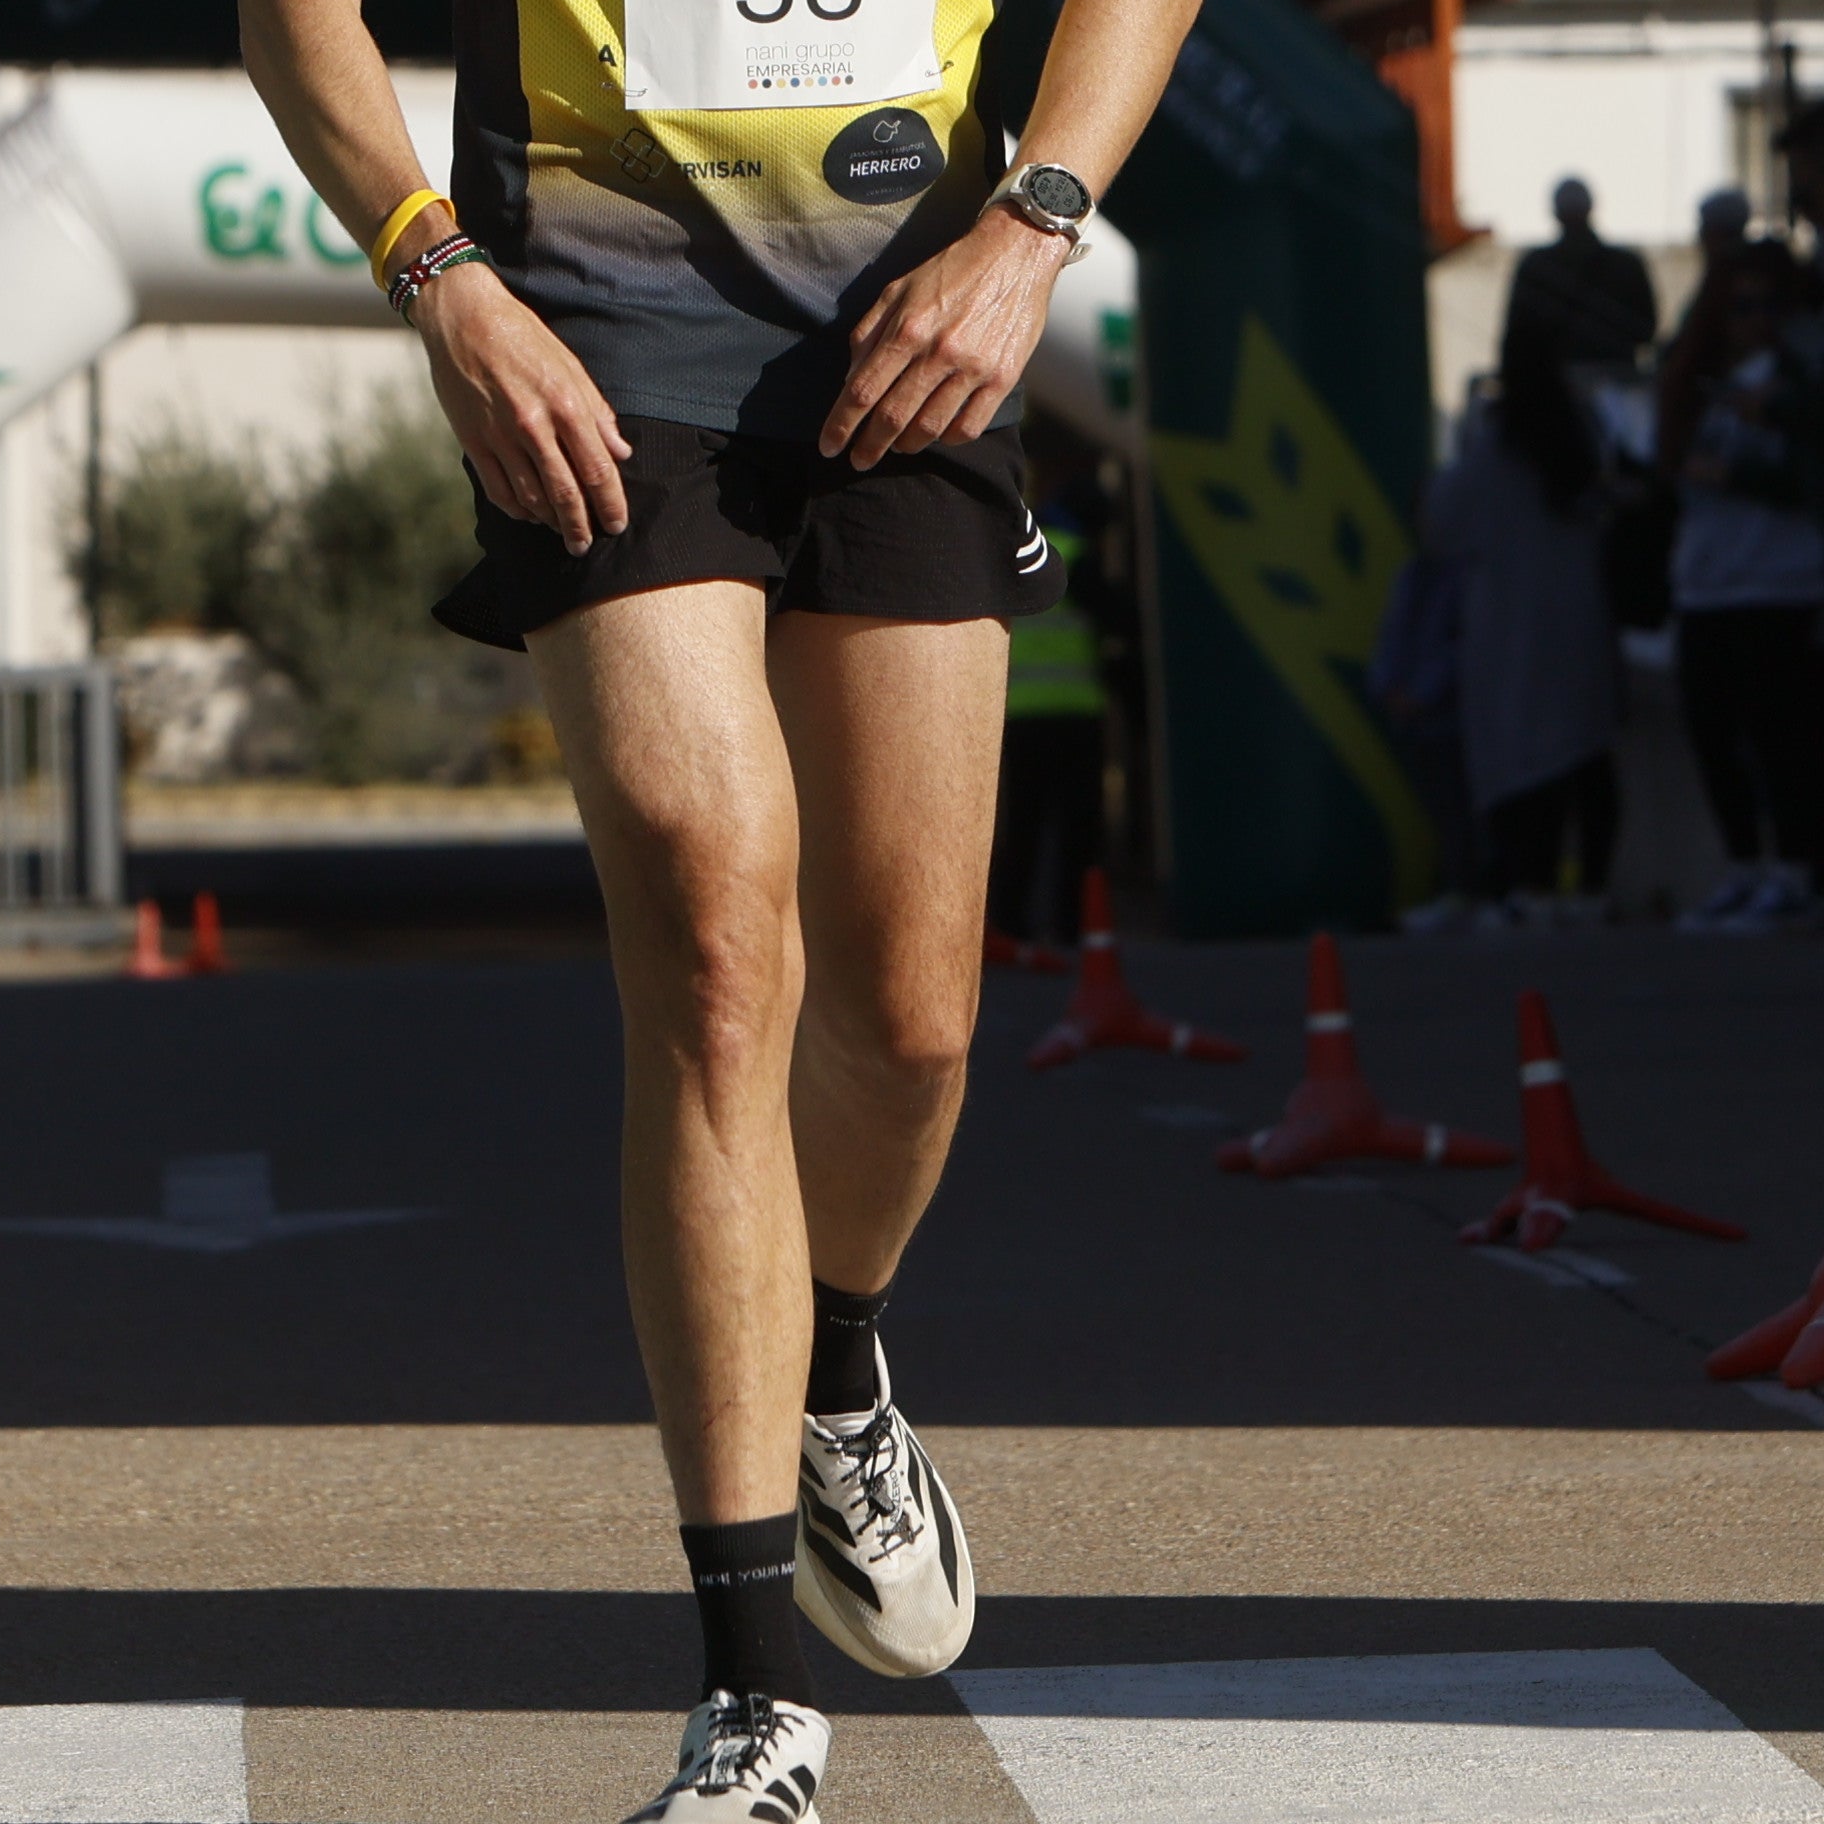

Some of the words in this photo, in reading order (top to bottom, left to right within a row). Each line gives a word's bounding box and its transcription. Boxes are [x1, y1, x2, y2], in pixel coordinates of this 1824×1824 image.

[746, 41, 788, 61] nani
[795, 42, 855, 63] grupo
[746, 62, 854, 78] EMPRESARIAL
[849, 155, 922, 178] HERRERO
